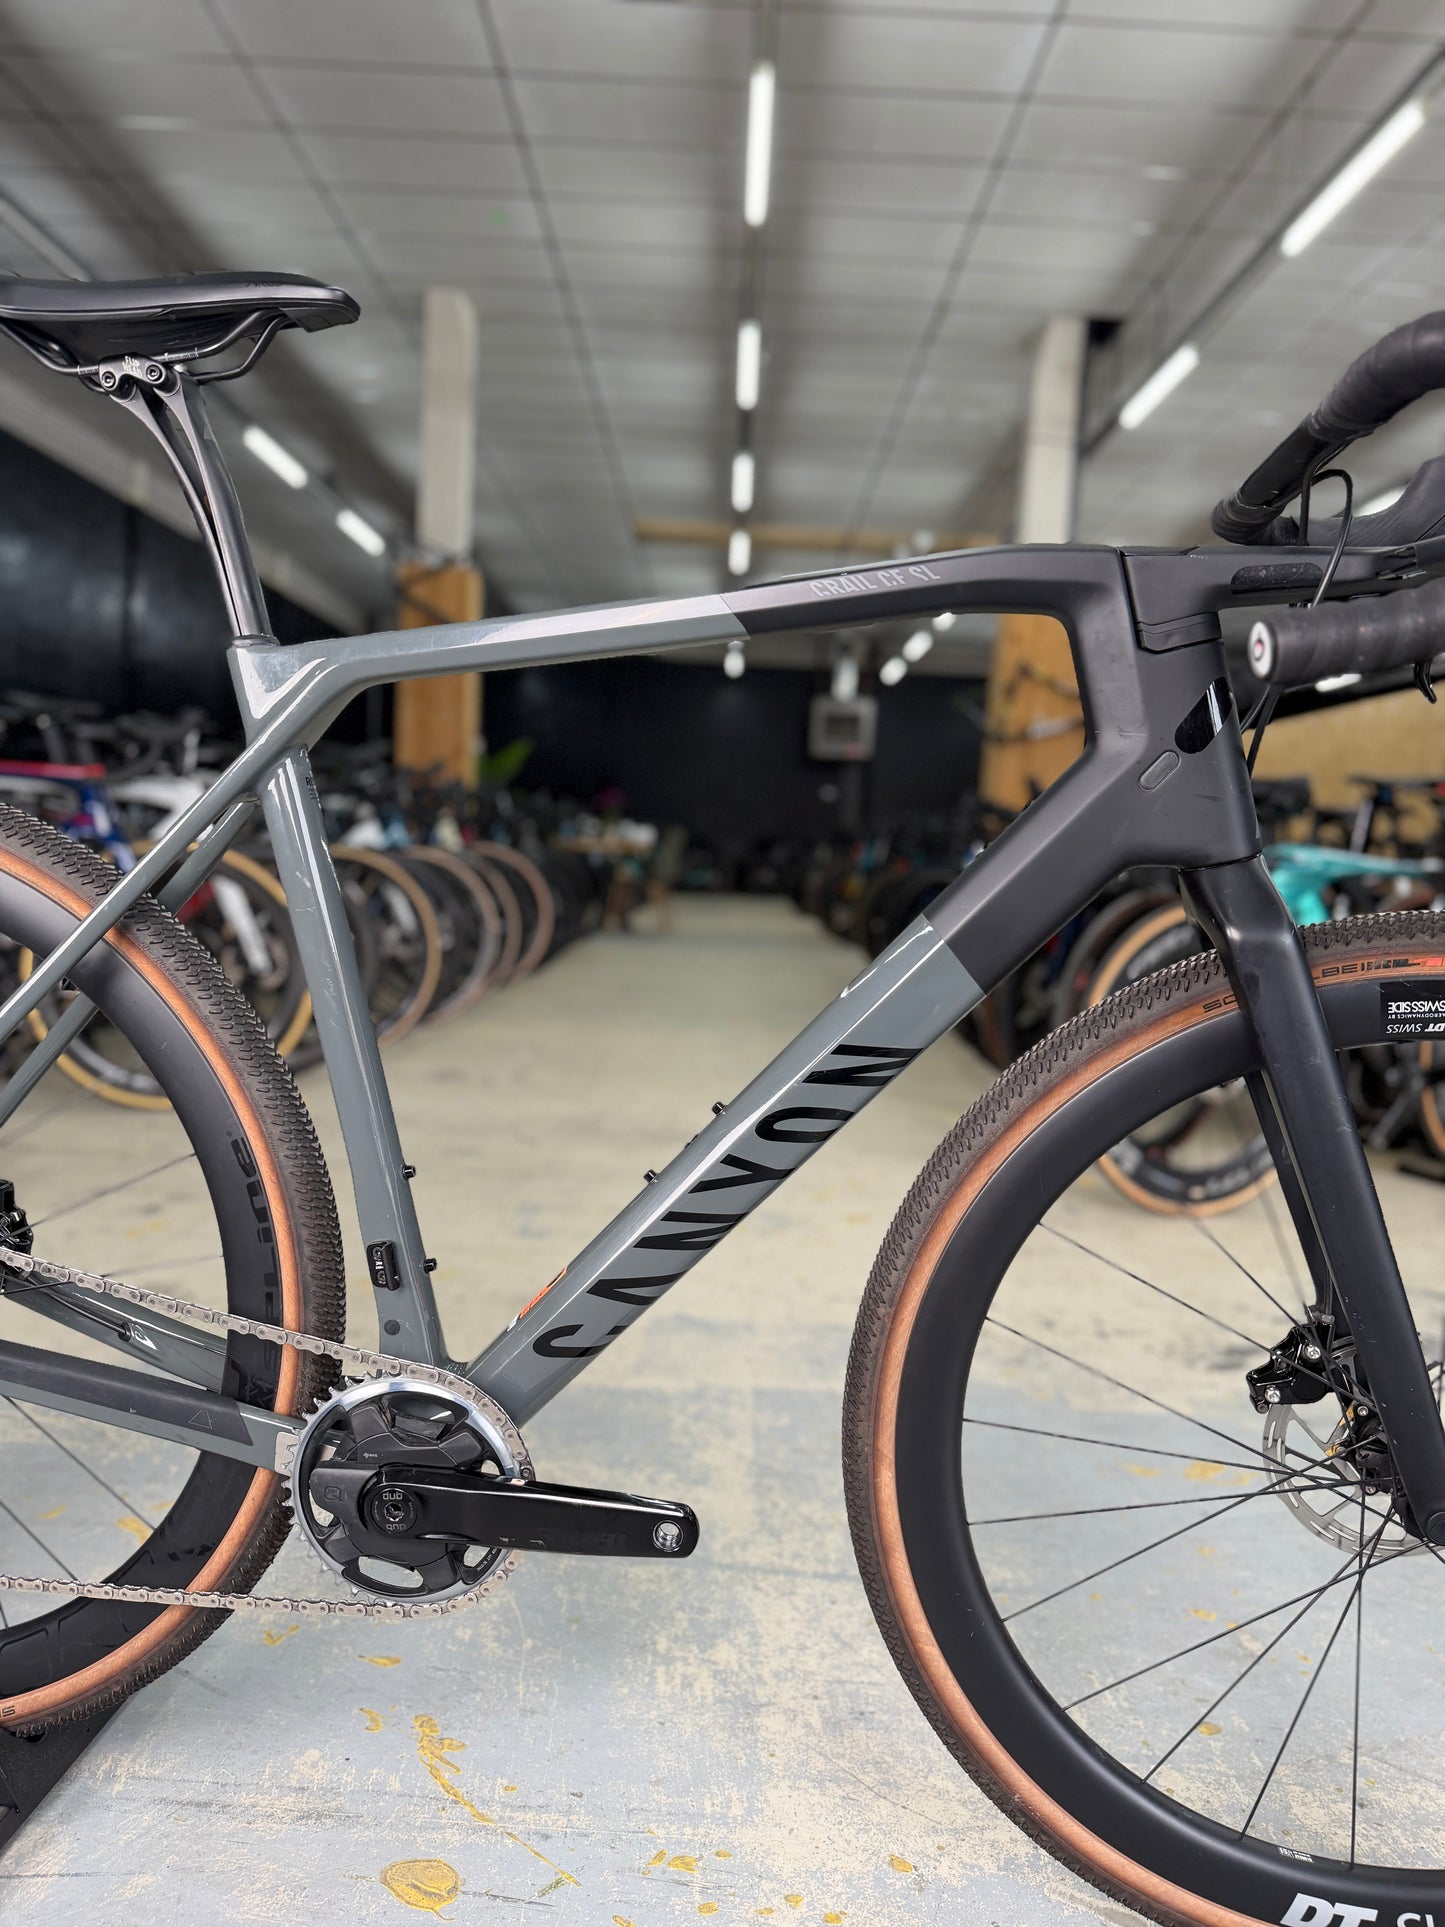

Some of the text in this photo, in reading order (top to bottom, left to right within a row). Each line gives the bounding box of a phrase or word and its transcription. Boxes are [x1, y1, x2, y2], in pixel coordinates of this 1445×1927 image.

[809, 564, 942, 597] GRAIL CF SL
[1385, 1023, 1422, 1034] SWISS
[532, 1043, 924, 1359] CANYON
